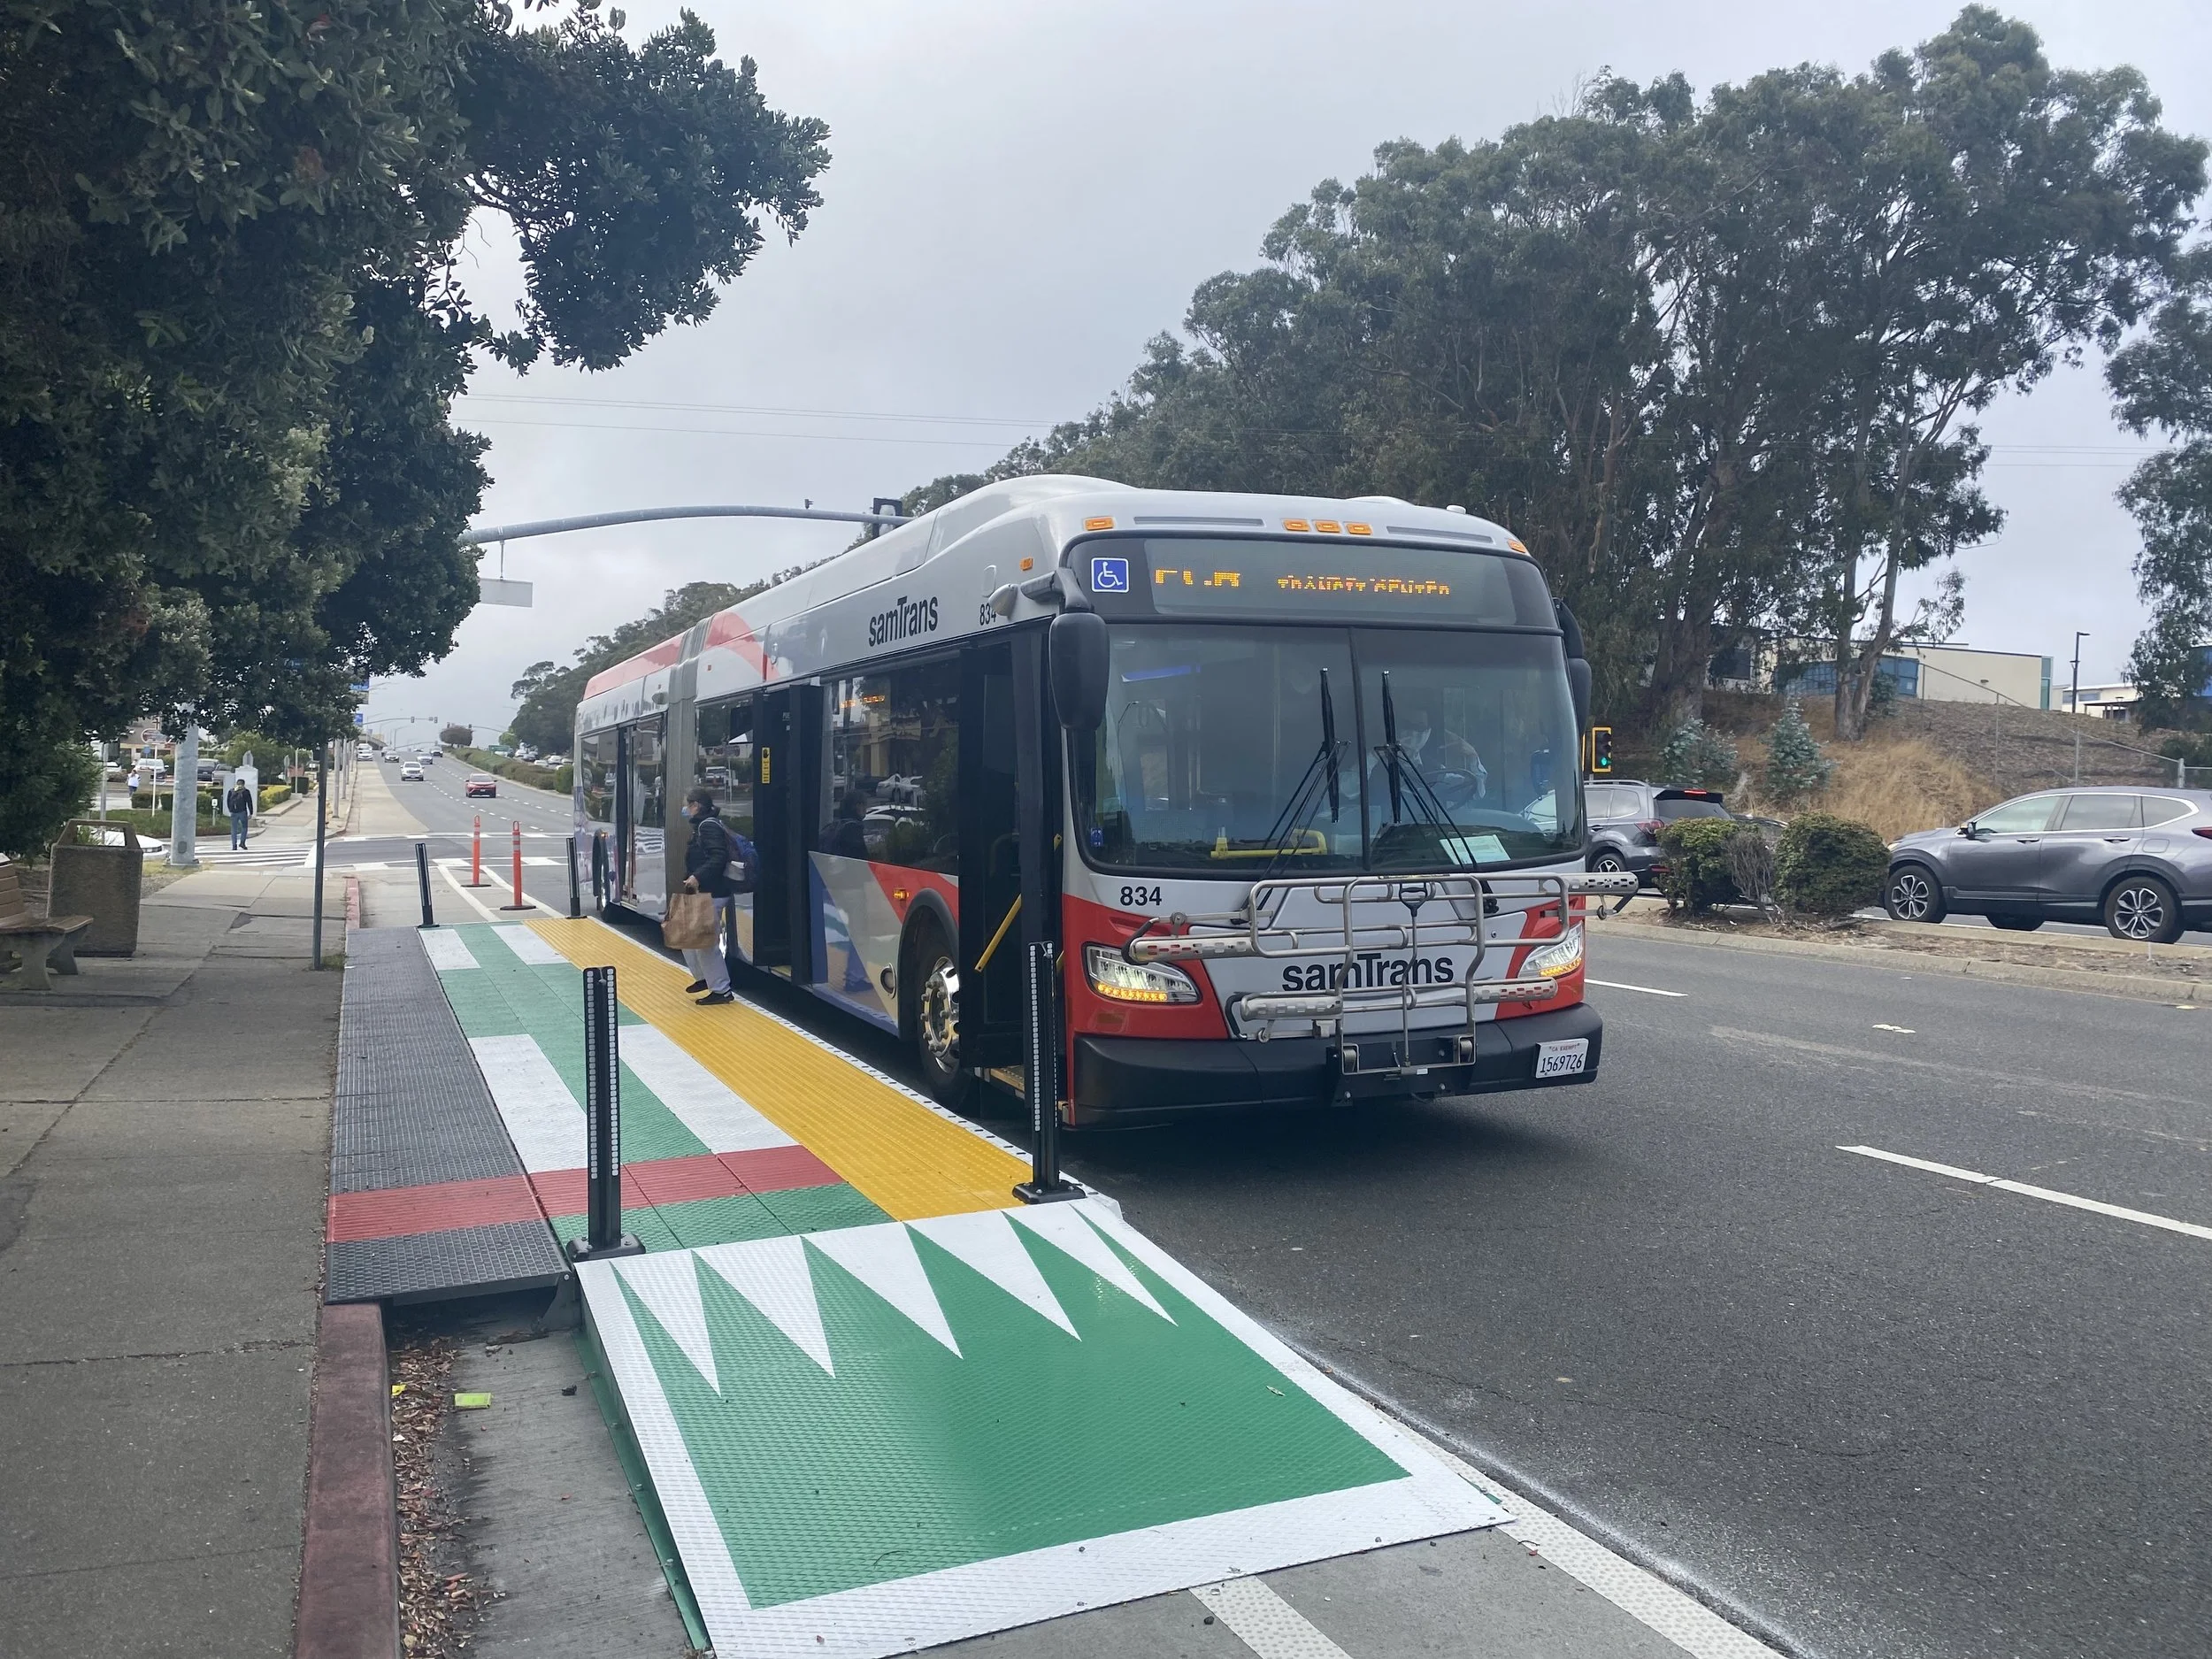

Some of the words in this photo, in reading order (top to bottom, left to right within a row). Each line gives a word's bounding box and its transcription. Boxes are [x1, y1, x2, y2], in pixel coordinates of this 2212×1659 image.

[868, 595, 938, 647] samTrans
[979, 603, 996, 626] 834
[1119, 886, 1163, 906] 834
[1282, 952, 1455, 992] samTrans
[1540, 1053, 1585, 1073] 1569726
